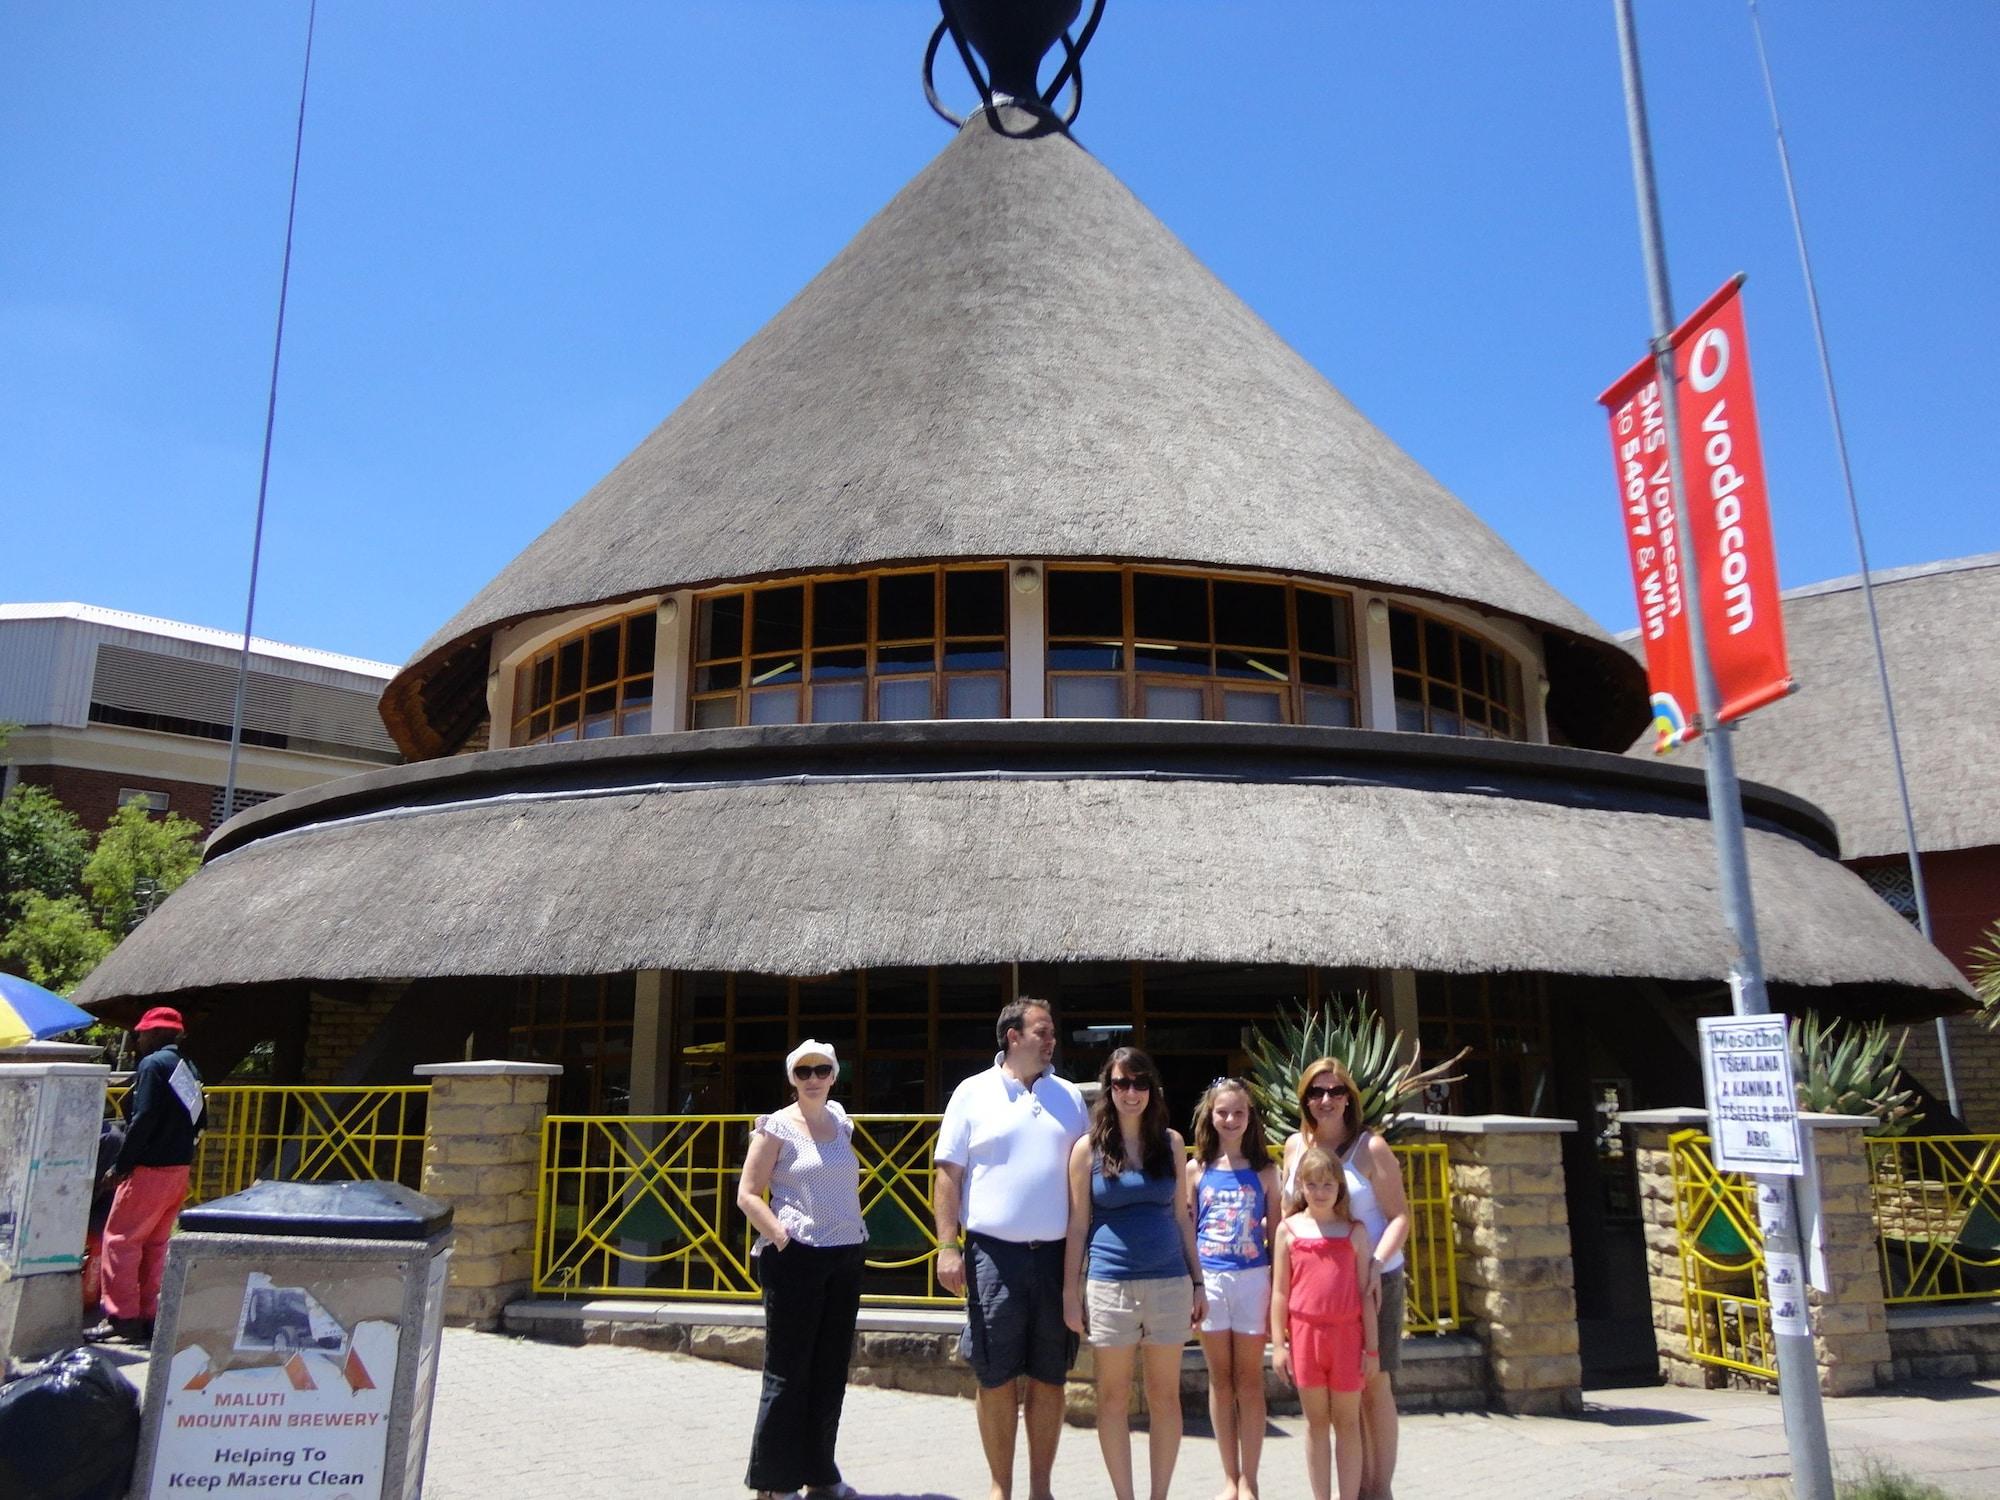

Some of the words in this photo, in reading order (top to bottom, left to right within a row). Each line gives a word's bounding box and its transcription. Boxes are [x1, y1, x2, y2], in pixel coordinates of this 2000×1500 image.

[1616, 401, 1633, 436] to
[1638, 380, 1665, 454] SMS
[1620, 436, 1651, 537] 54077
[1701, 399, 1754, 636] vodacom
[1650, 458, 1682, 618] Vodacom
[1641, 570, 1666, 641] Win
[1747, 1130, 1771, 1148] ABC
[214, 1392, 286, 1407] MALUTI
[176, 1413, 282, 1428] MOUNTAIN
[287, 1412, 379, 1427] BREWERY
[214, 1448, 295, 1466] Helping
[302, 1447, 326, 1462] To
[168, 1473, 221, 1491] Keep
[227, 1471, 301, 1487] Maseru
[308, 1470, 365, 1486] Clean
